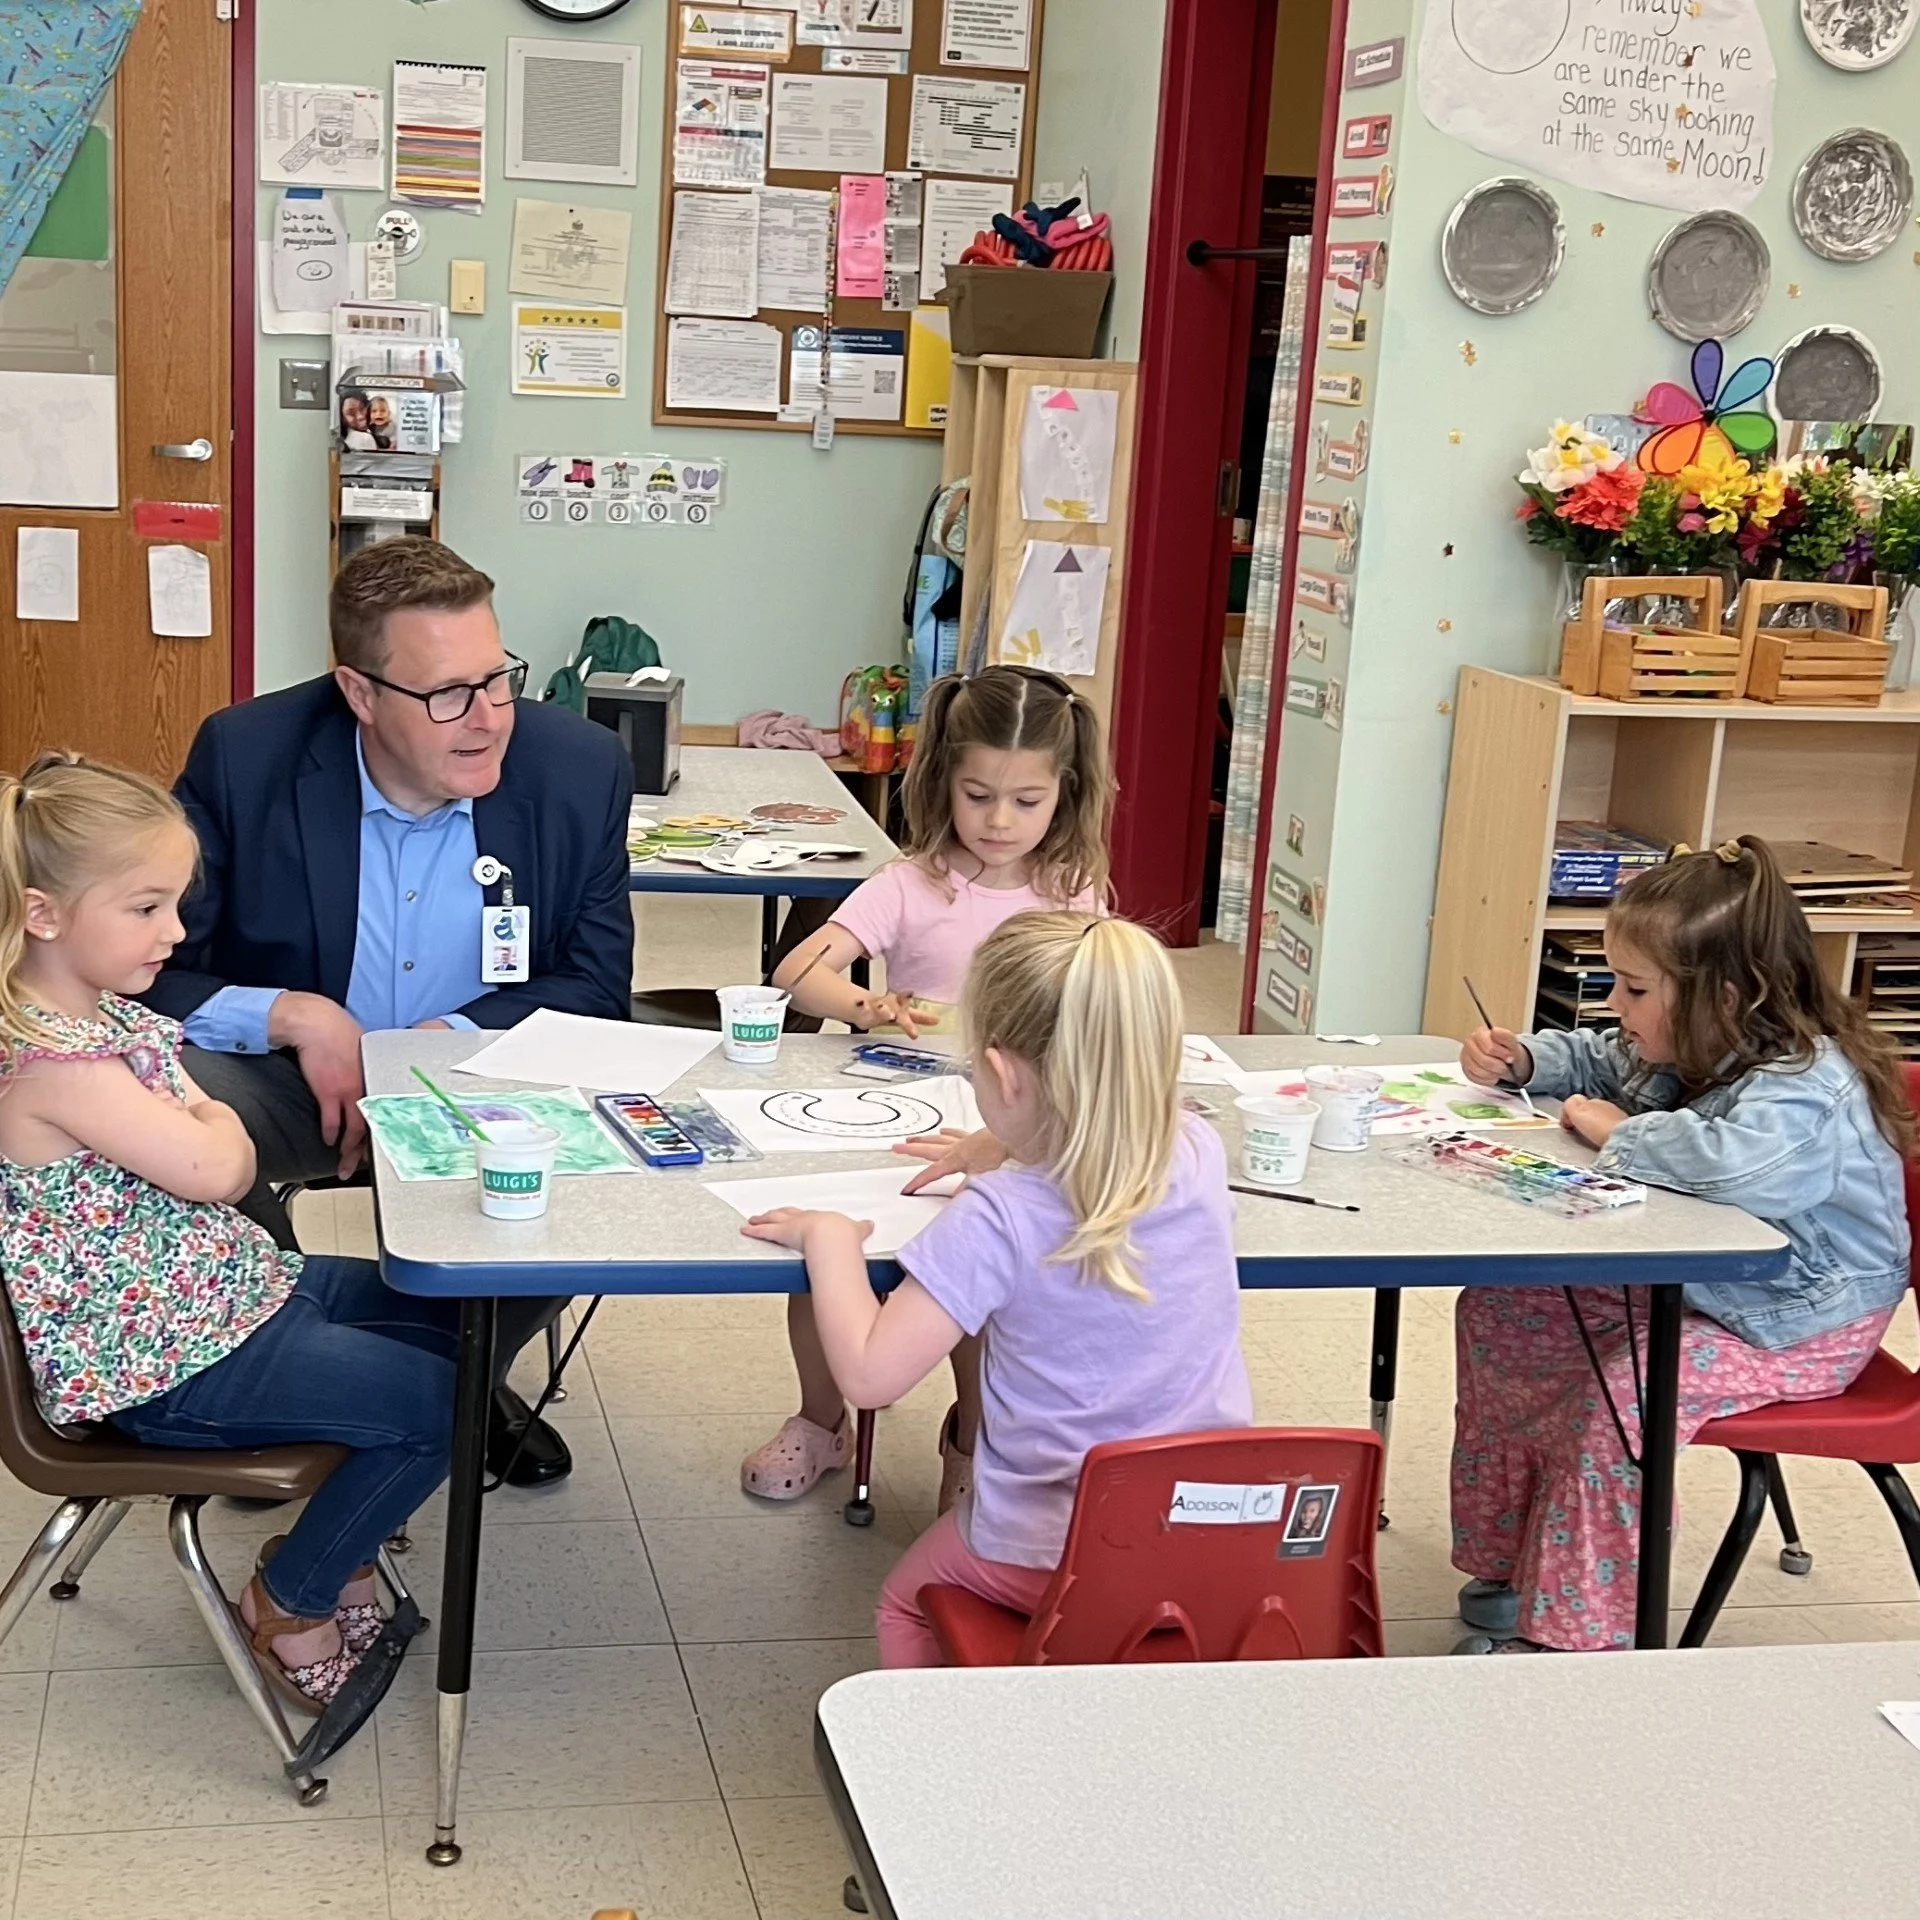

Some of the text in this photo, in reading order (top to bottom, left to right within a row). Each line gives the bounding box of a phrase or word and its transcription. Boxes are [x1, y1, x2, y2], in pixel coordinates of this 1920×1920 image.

[1582, 24, 1753, 71] remember we
[1554, 62, 1727, 102] are under the
[1628, 97, 1669, 138] sky
[1542, 119, 1562, 147] at
[1571, 122, 1604, 153] the
[1680, 138, 1767, 186] Moon!
[282, 209, 325, 221] We are
[282, 224, 301, 234] out
[316, 224, 334, 235] the
[485, 1171, 539, 1189] LUIGI'S
[1171, 1495, 1239, 1513] ADDISON
